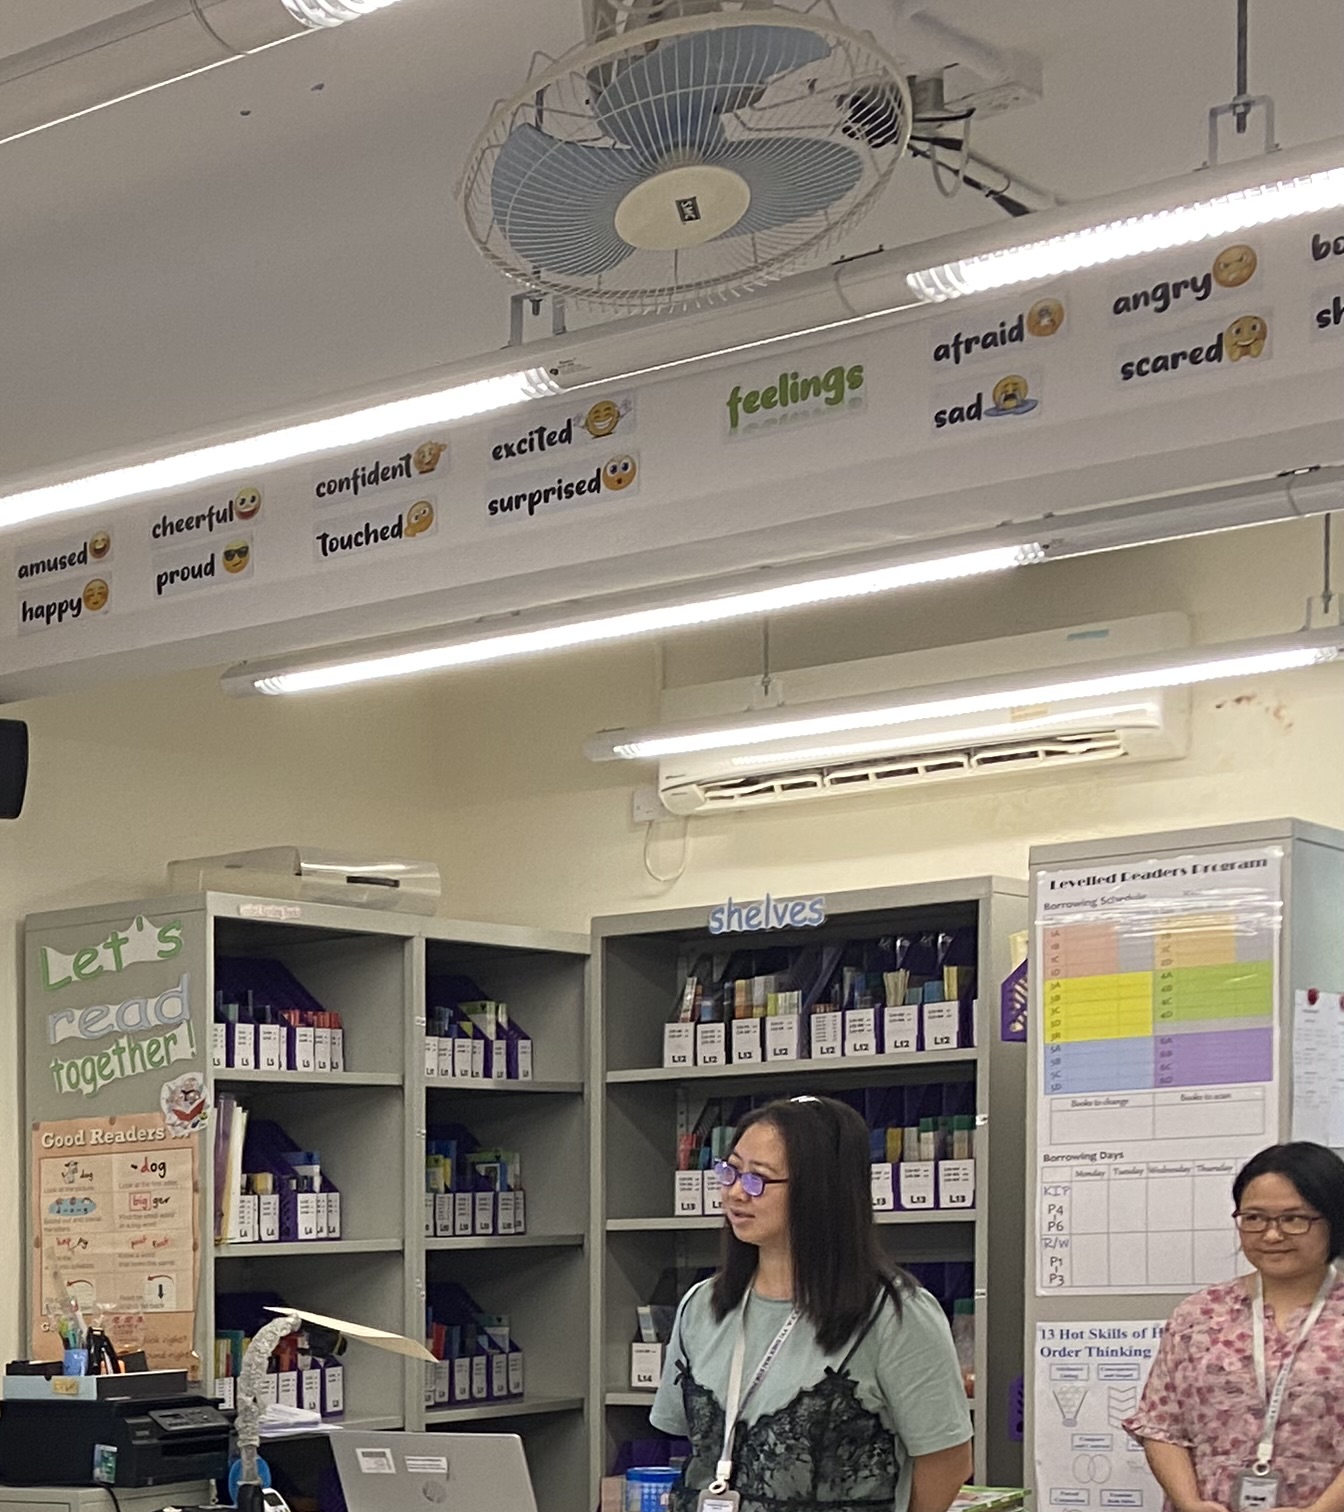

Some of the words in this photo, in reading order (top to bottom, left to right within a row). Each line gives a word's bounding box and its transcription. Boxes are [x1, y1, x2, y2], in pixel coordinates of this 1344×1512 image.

[1114, 269, 1212, 316] angry
[933, 321, 1024, 364] afraid
[1121, 335, 1223, 381] scared
[727, 363, 864, 429] feelings
[934, 394, 982, 428] sad
[492, 419, 572, 462] excited
[316, 454, 412, 499] confident
[488, 469, 601, 518] surprised
[152, 501, 234, 540] cheerful
[18, 547, 87, 579] amused
[156, 554, 215, 593] proud
[21, 598, 82, 623] happy
[1050, 873, 1116, 890] Levelled
[1121, 864, 1187, 882] Readers
[1192, 858, 1267, 874] Program
[710, 893, 824, 932] shelves
[39, 915, 183, 991] Let's
[49, 974, 190, 1045] read
[42, 1132, 86, 1148] Good
[90, 1128, 164, 1144] Readers
[1043, 1152, 1097, 1162] Borrowing
[1100, 1152, 1124, 1160] Days
[1048, 1204, 1063, 1214] P4
[1048, 1221, 1064, 1231] P6
[1050, 1257, 1063, 1266] P1
[1050, 1274, 1064, 1286] P3
[1041, 1328, 1054, 1339] 13
[1058, 1328, 1081, 1340] Hot
[1085, 1328, 1122, 1339] Skills
[1127, 1327, 1147, 1339] of
[1040, 1347, 1082, 1359] Order
[1086, 1345, 1151, 1360] Thinking
